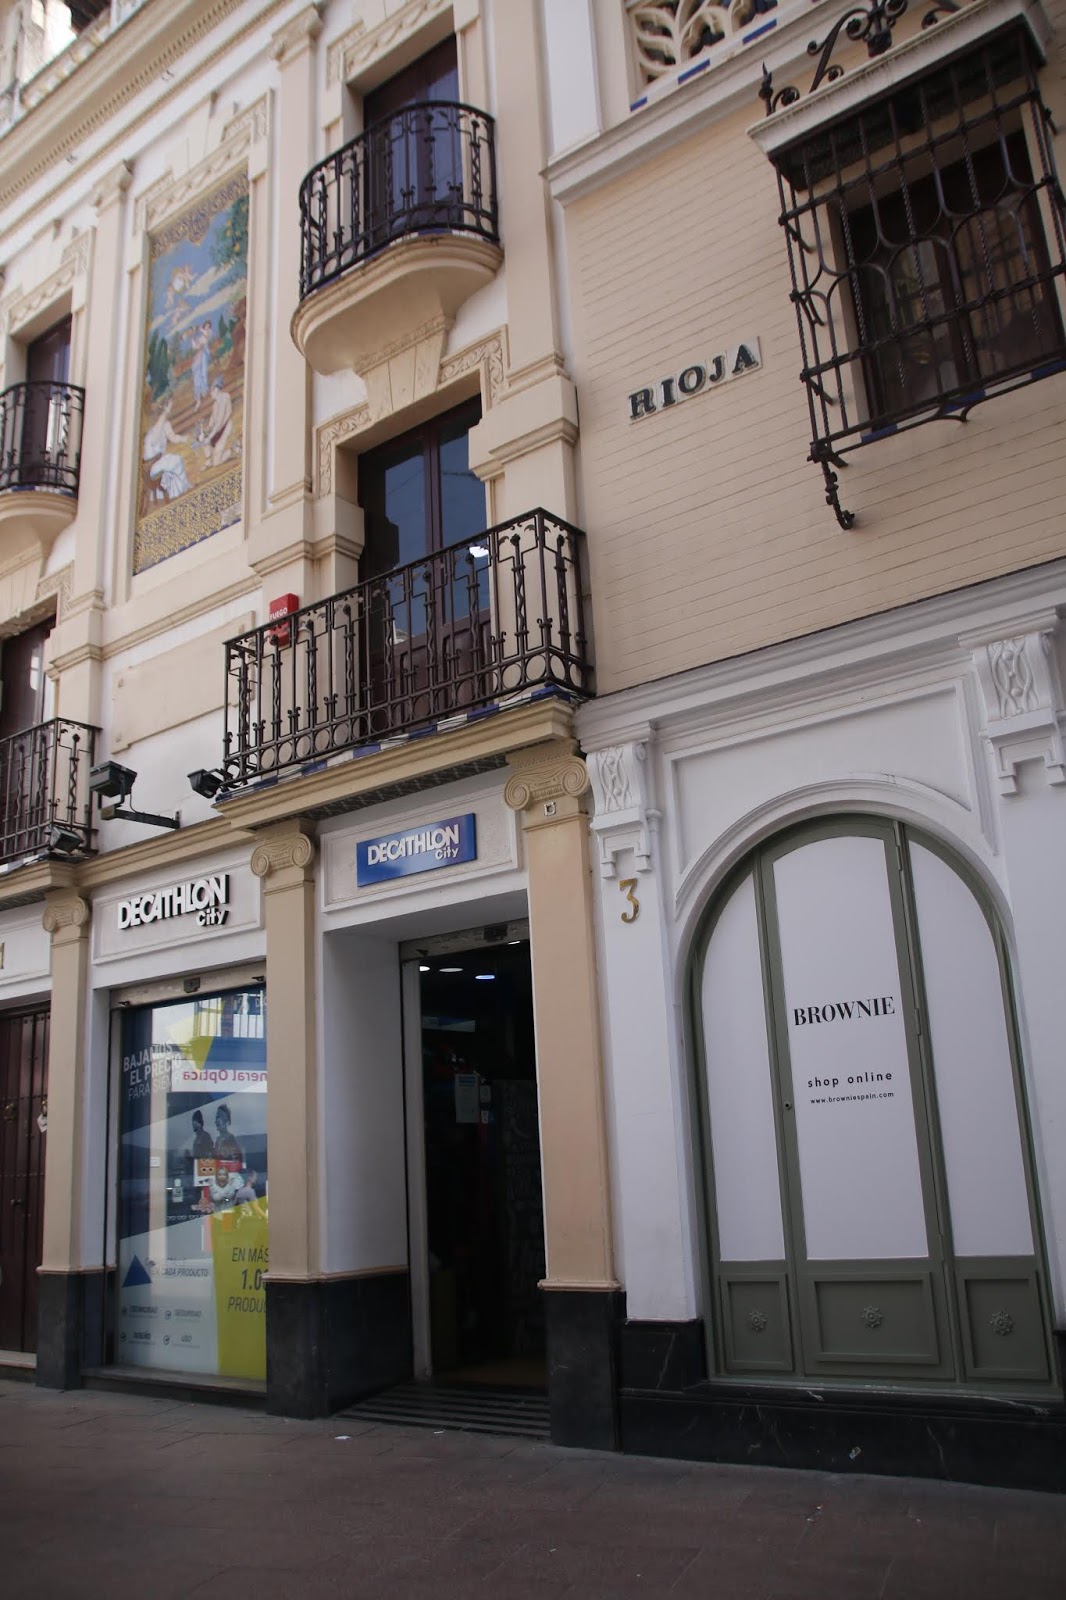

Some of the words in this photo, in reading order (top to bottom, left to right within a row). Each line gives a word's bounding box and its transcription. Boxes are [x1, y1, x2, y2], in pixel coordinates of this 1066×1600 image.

[628, 344, 759, 420] RIOJA
[270, 607, 288, 619] FUEGO
[367, 824, 460, 866] DECATHLON
[435, 845, 459, 860] City
[117, 874, 229, 930] DECATHLON
[619, 878, 640, 923] 3
[196, 907, 229, 927] City
[793, 996, 895, 1026] BROWNIE
[130, 1069, 142, 1086] EL
[808, 1077, 839, 1088] shop
[847, 1072, 893, 1084] online
[810, 1092, 895, 1104] www.browniespain.com
[232, 1247, 246, 1262] EN
[177, 1267, 209, 1277] PRODUCTO
